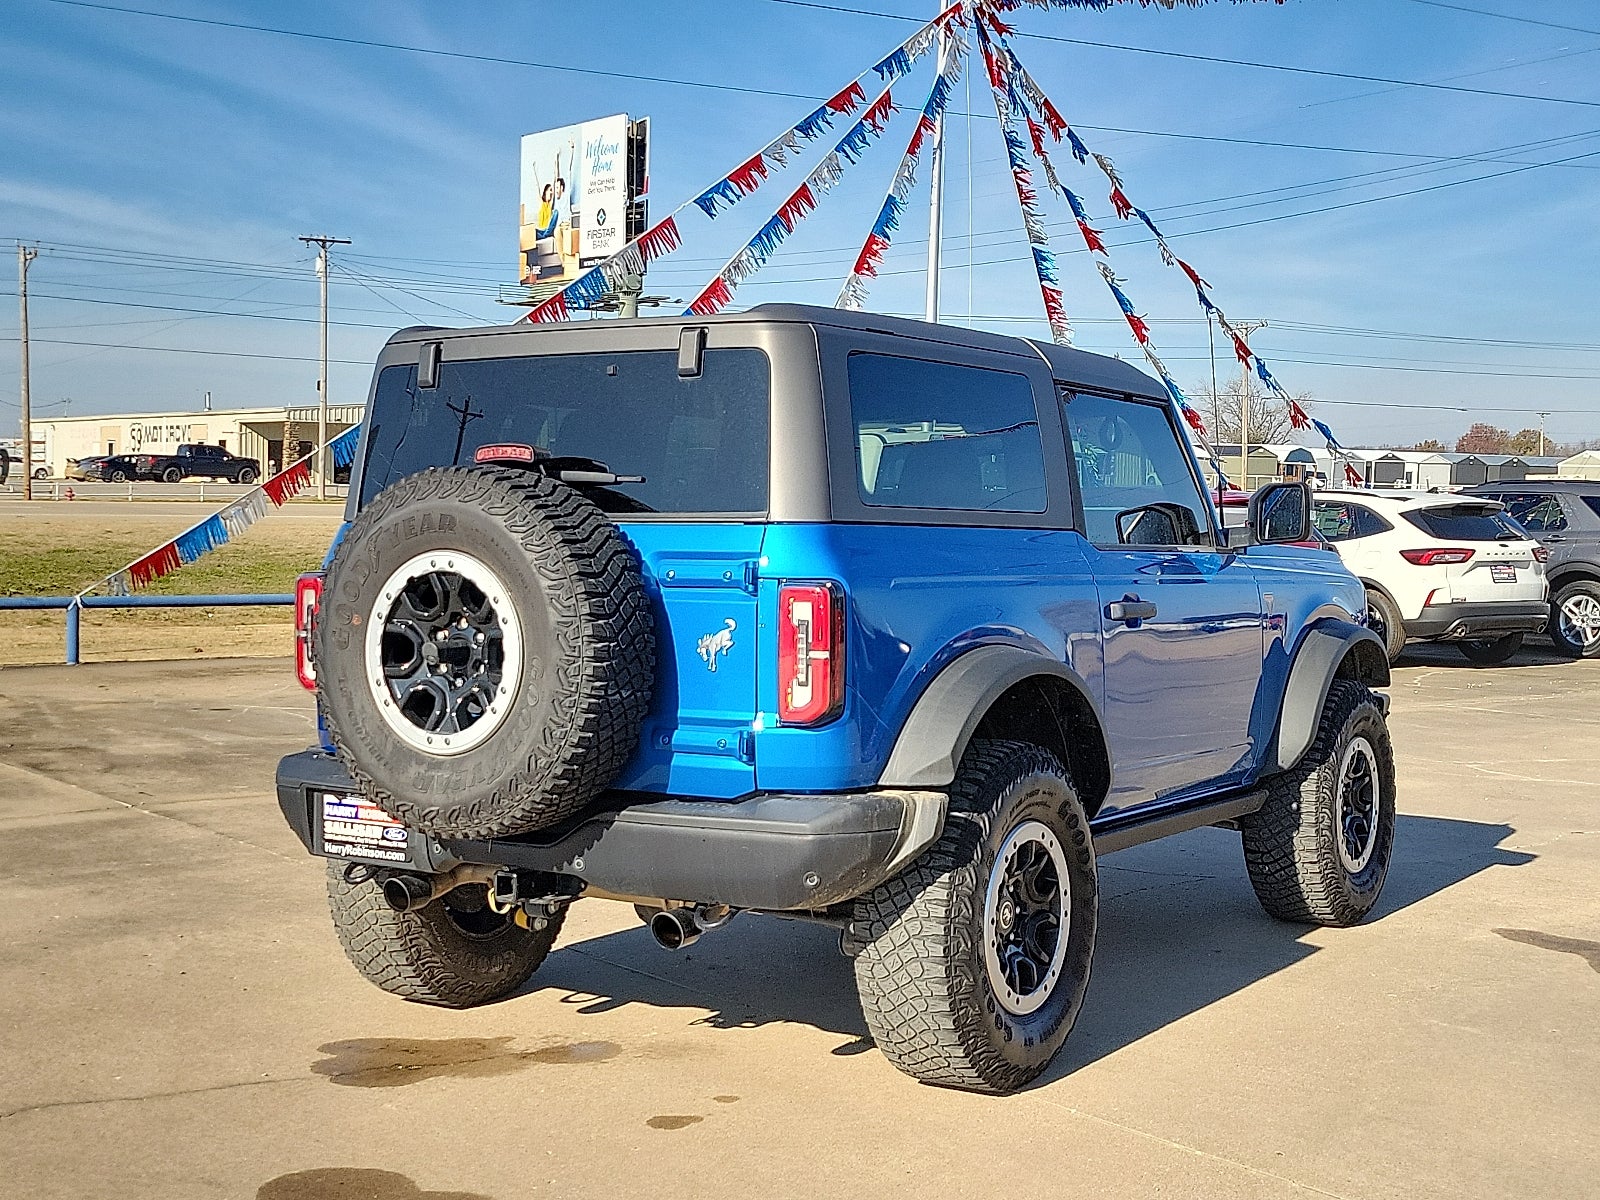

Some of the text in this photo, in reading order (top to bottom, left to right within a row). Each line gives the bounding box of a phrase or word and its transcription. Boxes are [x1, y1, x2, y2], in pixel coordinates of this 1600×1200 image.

[586, 135, 619, 159] Welcome
[592, 157, 612, 176] Home
[587, 228, 616, 240] FIRSTAR
[593, 239, 610, 249] BANK
[325, 804, 357, 819] HARRY
[324, 842, 406, 861] HarryRobinson.com
